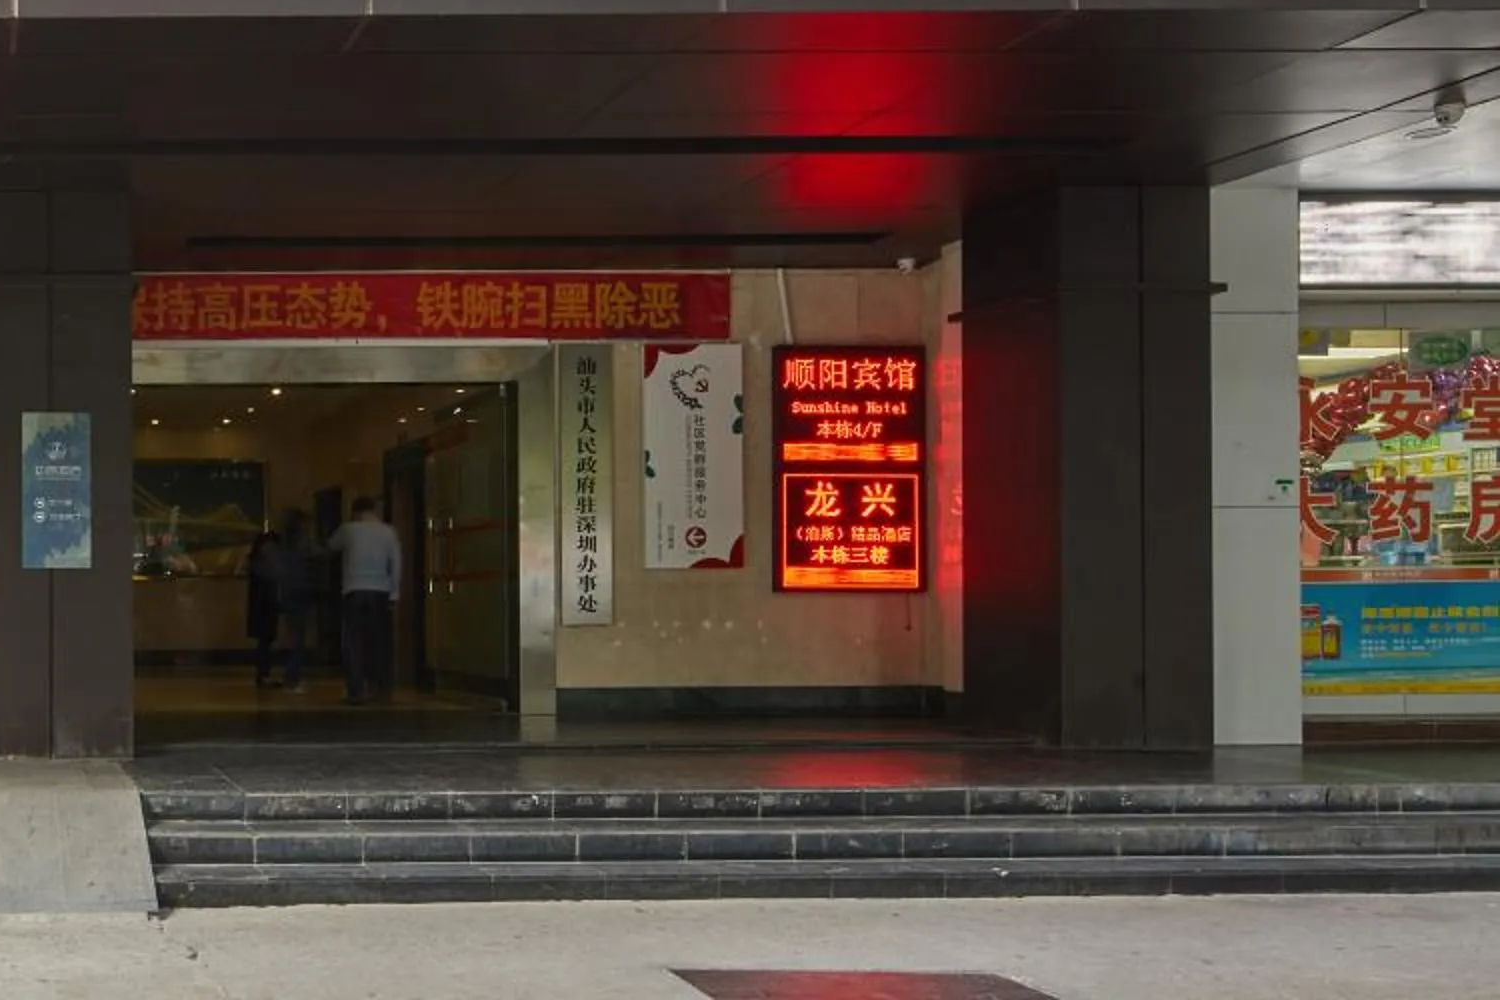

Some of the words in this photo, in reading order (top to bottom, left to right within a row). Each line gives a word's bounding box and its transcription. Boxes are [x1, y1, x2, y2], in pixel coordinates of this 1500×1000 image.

[783, 357, 916, 391] 顺阳宾馆
[791, 401, 859, 414] Sunshine
[865, 401, 907, 415] Hotel
[816, 420, 882, 439] 本栋4/F
[576, 356, 597, 613] 汕头市人民政府驻深圳办事处
[810, 545, 890, 565] 本栋三楼
